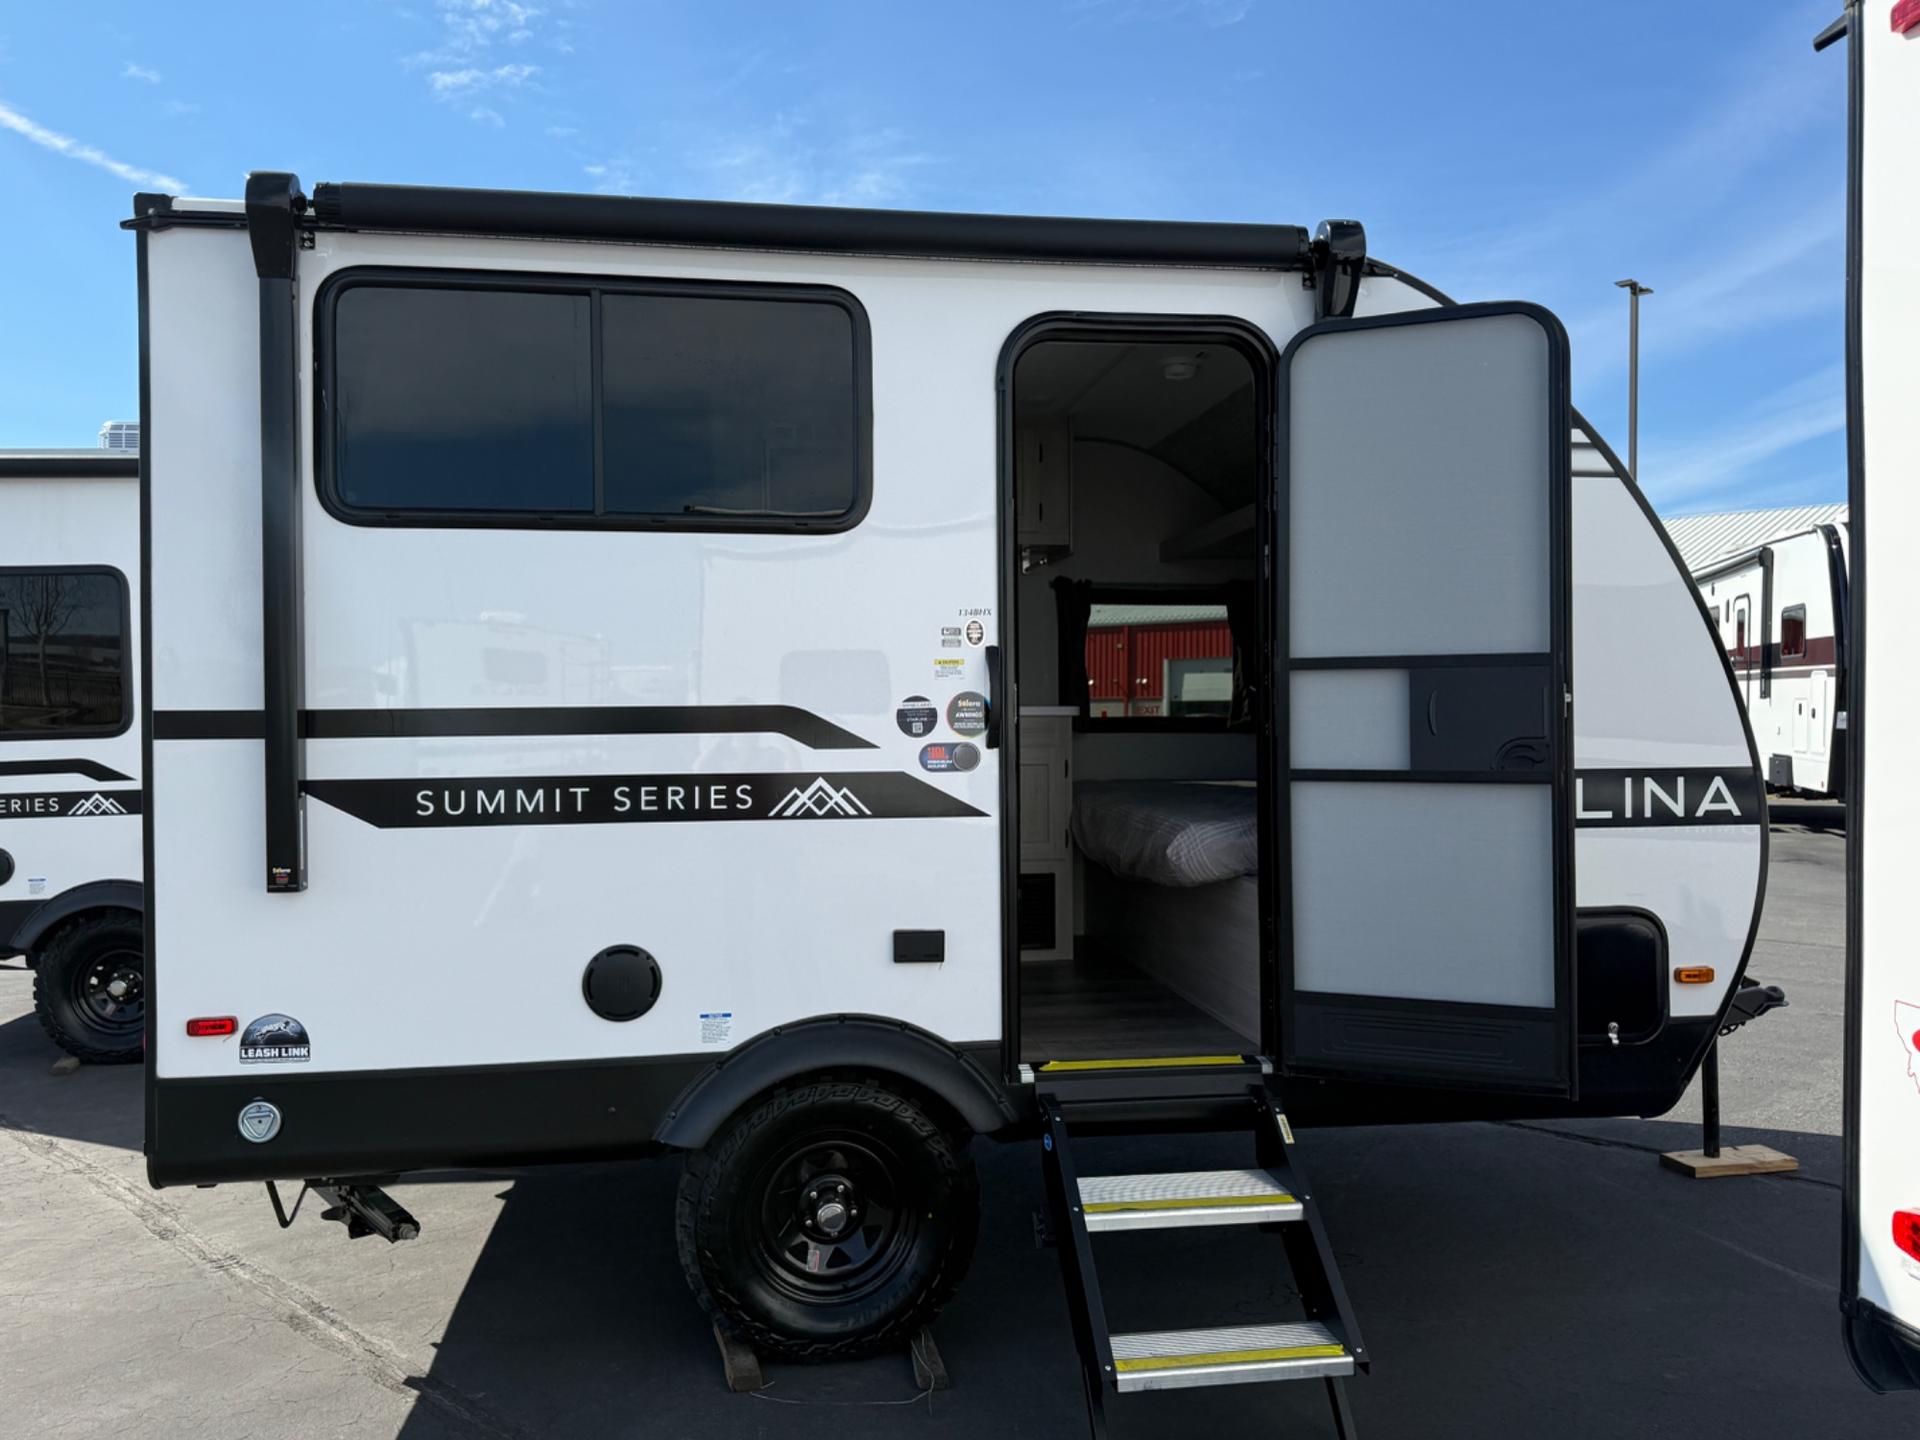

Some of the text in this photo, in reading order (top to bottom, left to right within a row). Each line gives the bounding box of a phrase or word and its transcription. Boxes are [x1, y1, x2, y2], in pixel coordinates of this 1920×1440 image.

[1136, 705, 1161, 715] EXIT
[415, 784, 754, 817] SUMMIT SERIES
[1575, 776, 1742, 819] LINA
[241, 1047, 309, 1058] LEASH LINK
